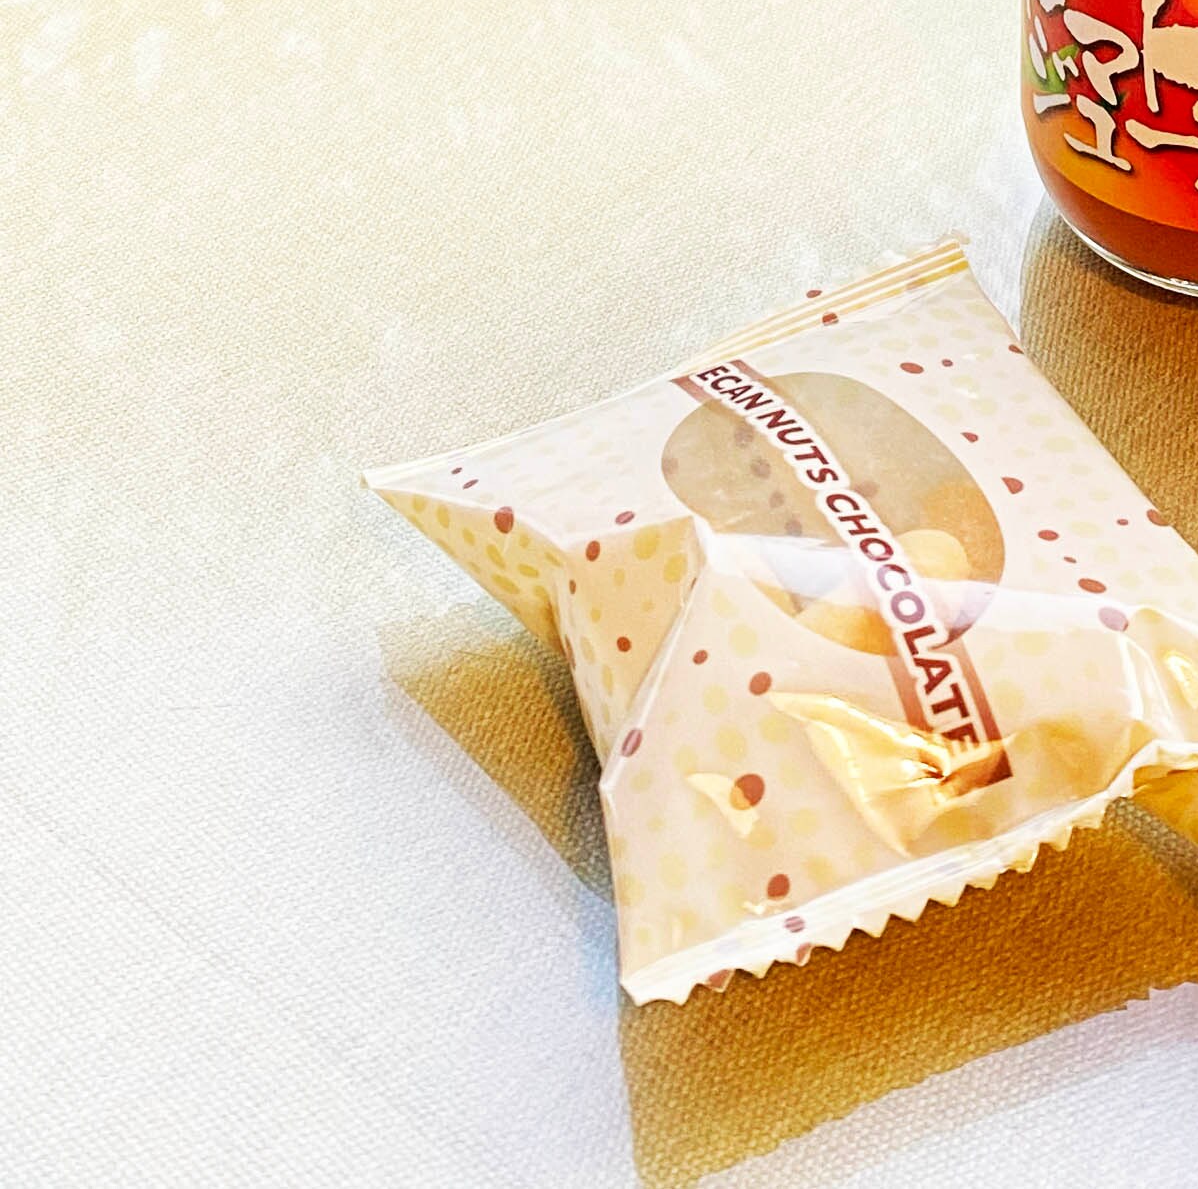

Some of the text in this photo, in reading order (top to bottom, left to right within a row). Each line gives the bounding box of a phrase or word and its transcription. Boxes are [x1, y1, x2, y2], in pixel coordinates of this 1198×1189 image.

[696, 365, 980, 756] ECAN NUTS CHOCOLATE
